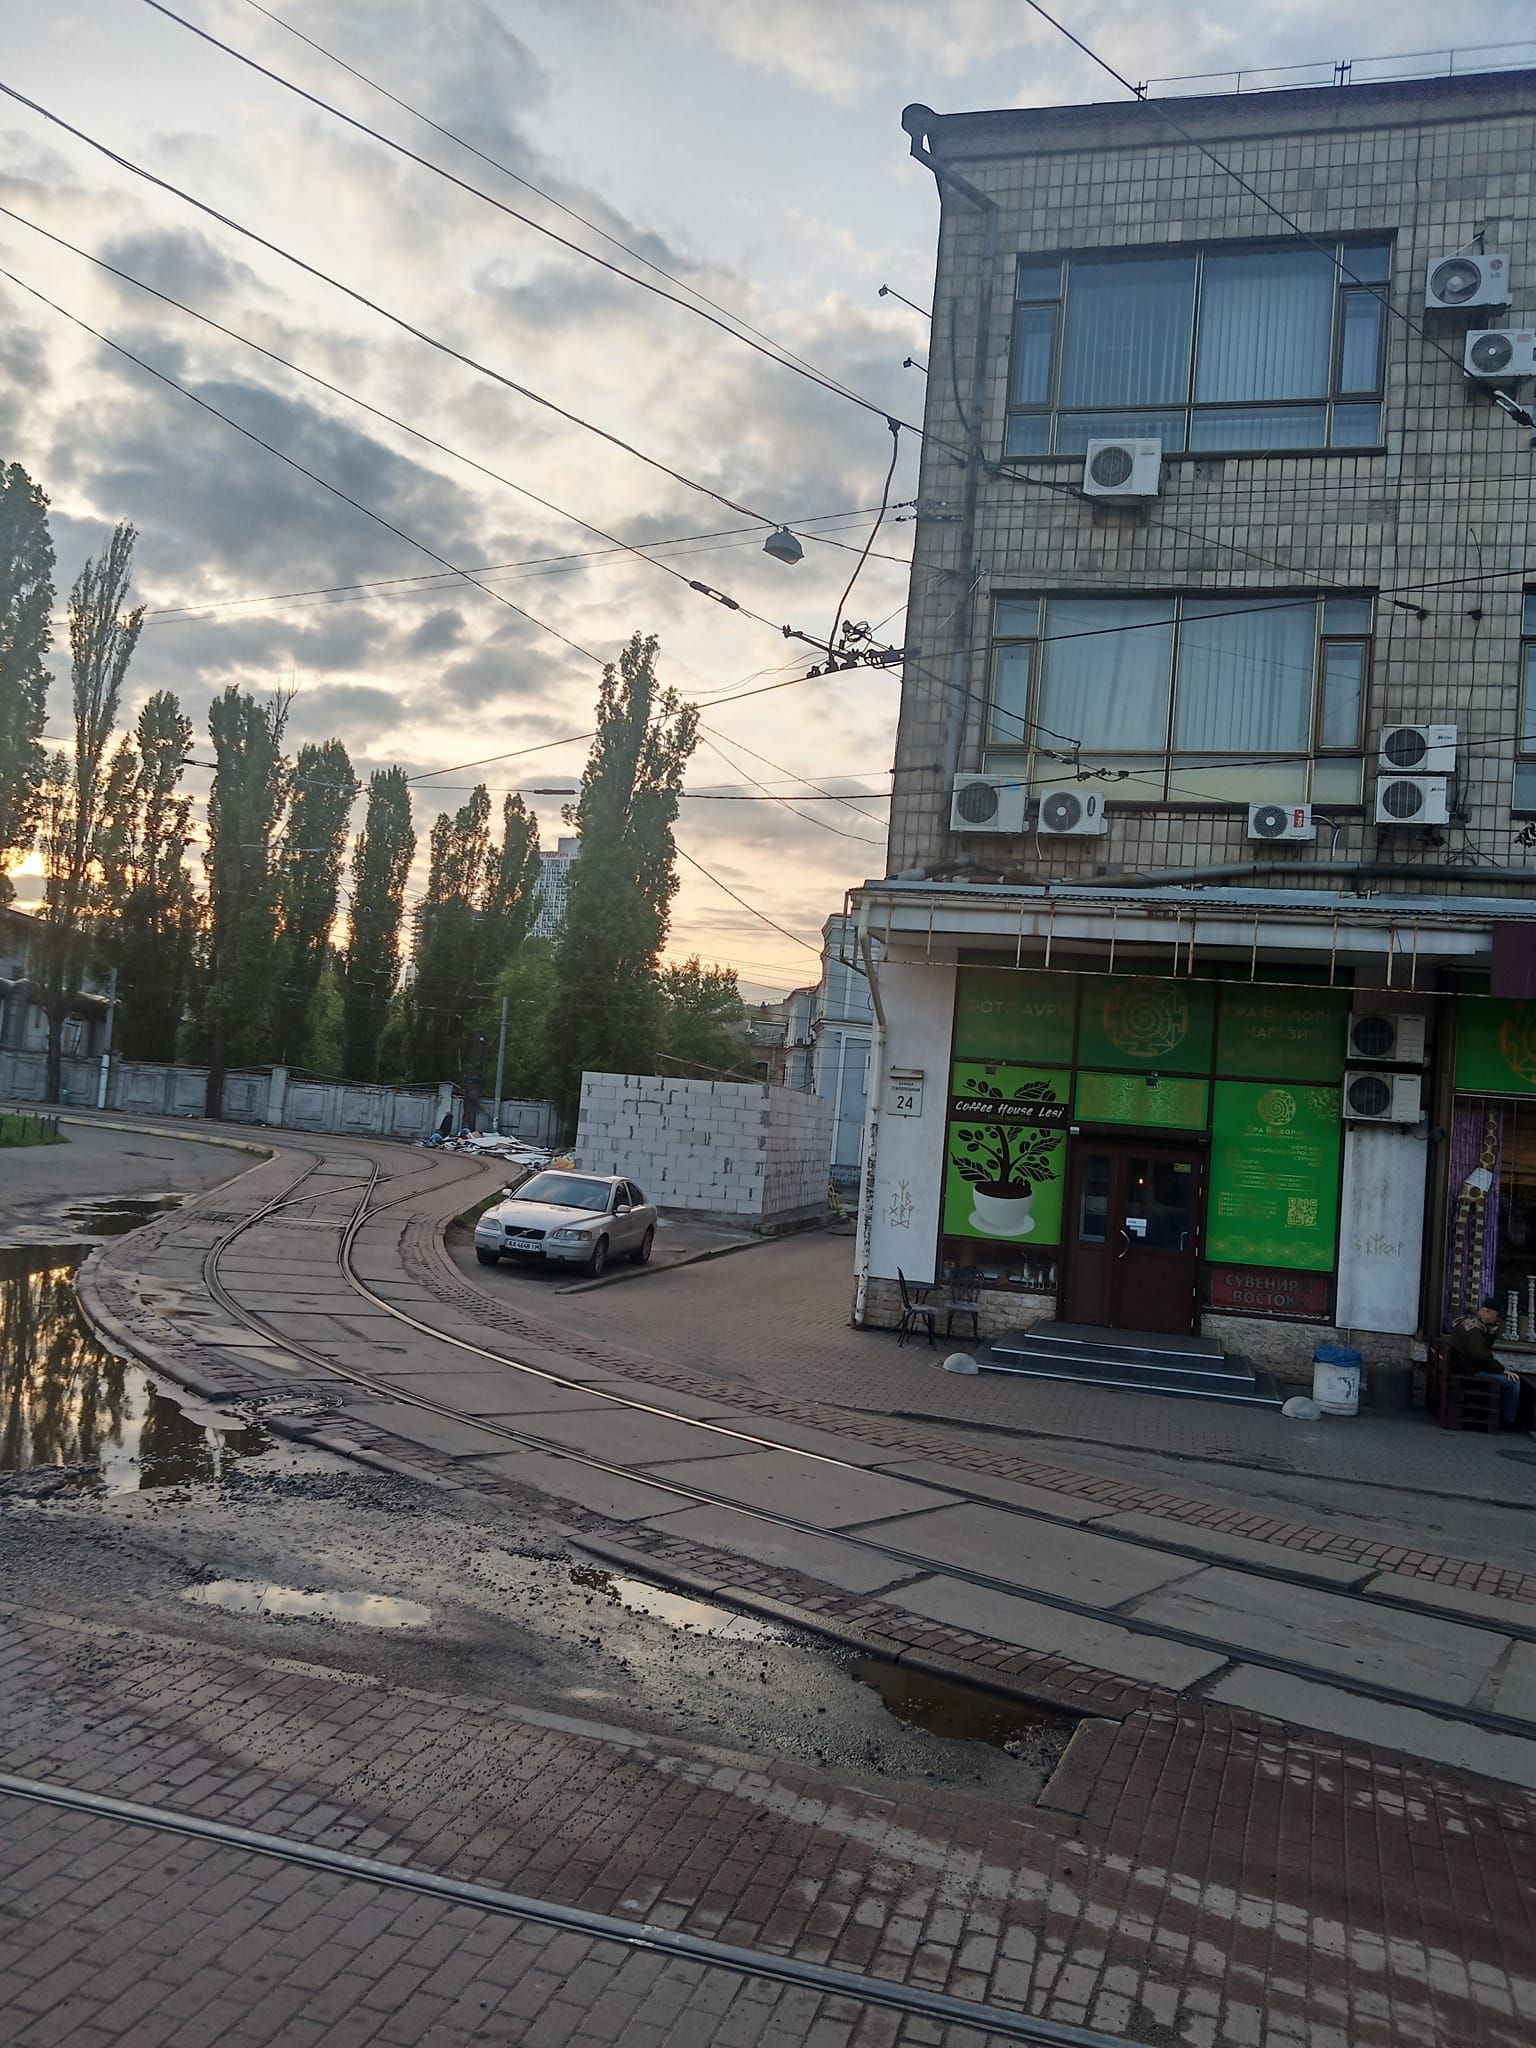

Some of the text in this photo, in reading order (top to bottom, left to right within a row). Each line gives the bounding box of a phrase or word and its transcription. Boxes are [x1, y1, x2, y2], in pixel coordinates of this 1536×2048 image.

[896, 1095, 913, 1110] 24
[955, 1101, 1065, 1118] Coffee House Lesi
